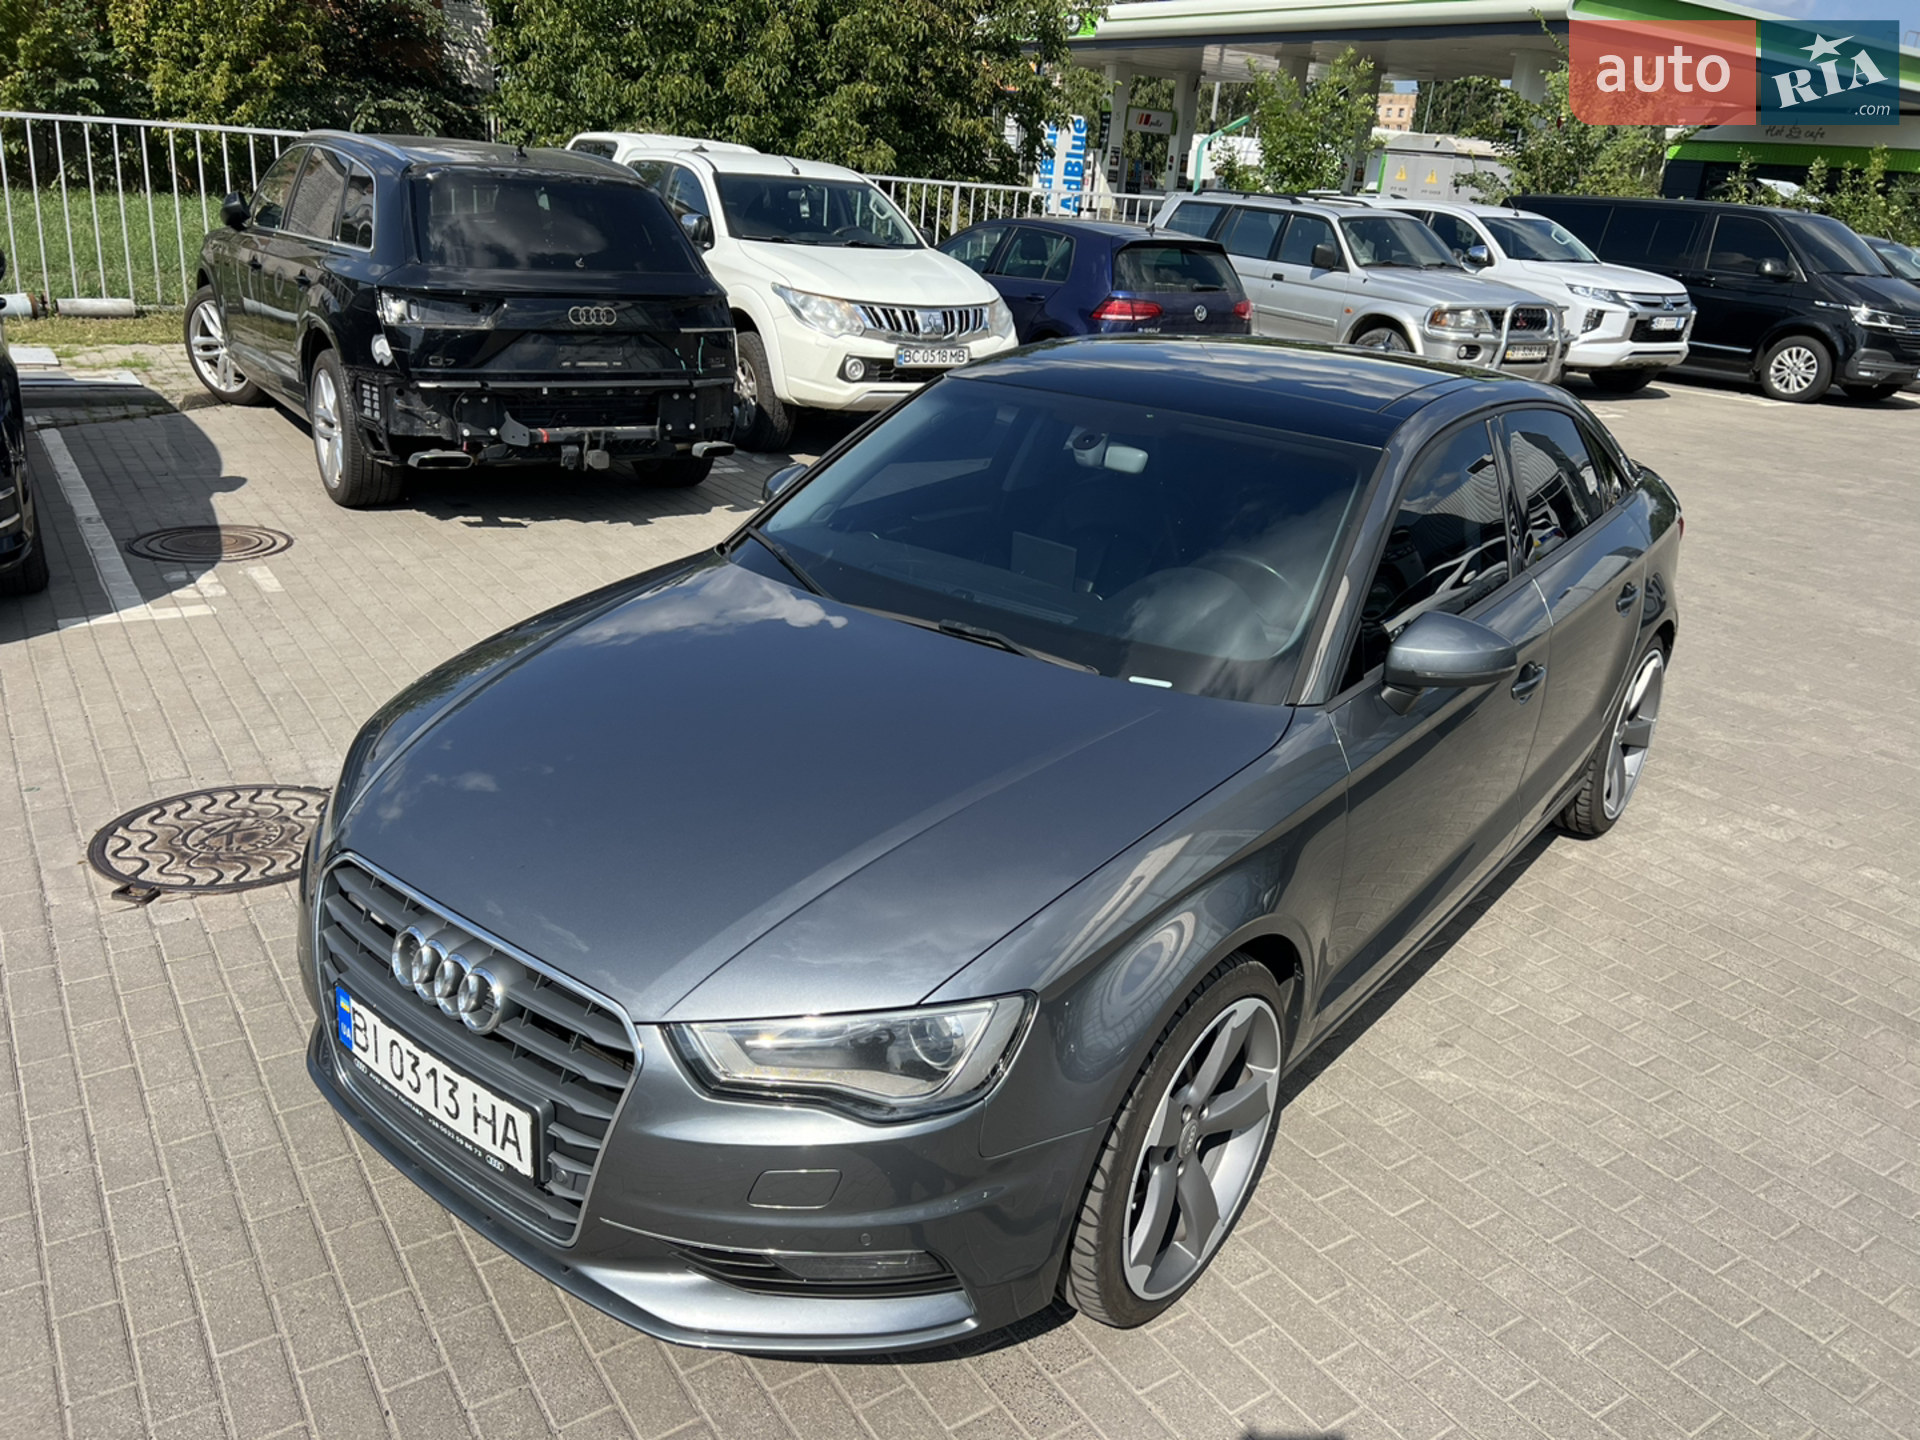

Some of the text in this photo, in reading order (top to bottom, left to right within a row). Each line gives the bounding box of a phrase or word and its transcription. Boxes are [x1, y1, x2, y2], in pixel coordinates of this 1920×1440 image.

[1765, 124, 1785, 138] Hot
[1060, 117, 1087, 214] AdBlue
[903, 349, 966, 364] BC 0518 MB
[340, 1022, 352, 1041] UA
[352, 1006, 523, 1164] BI 0313 HA
